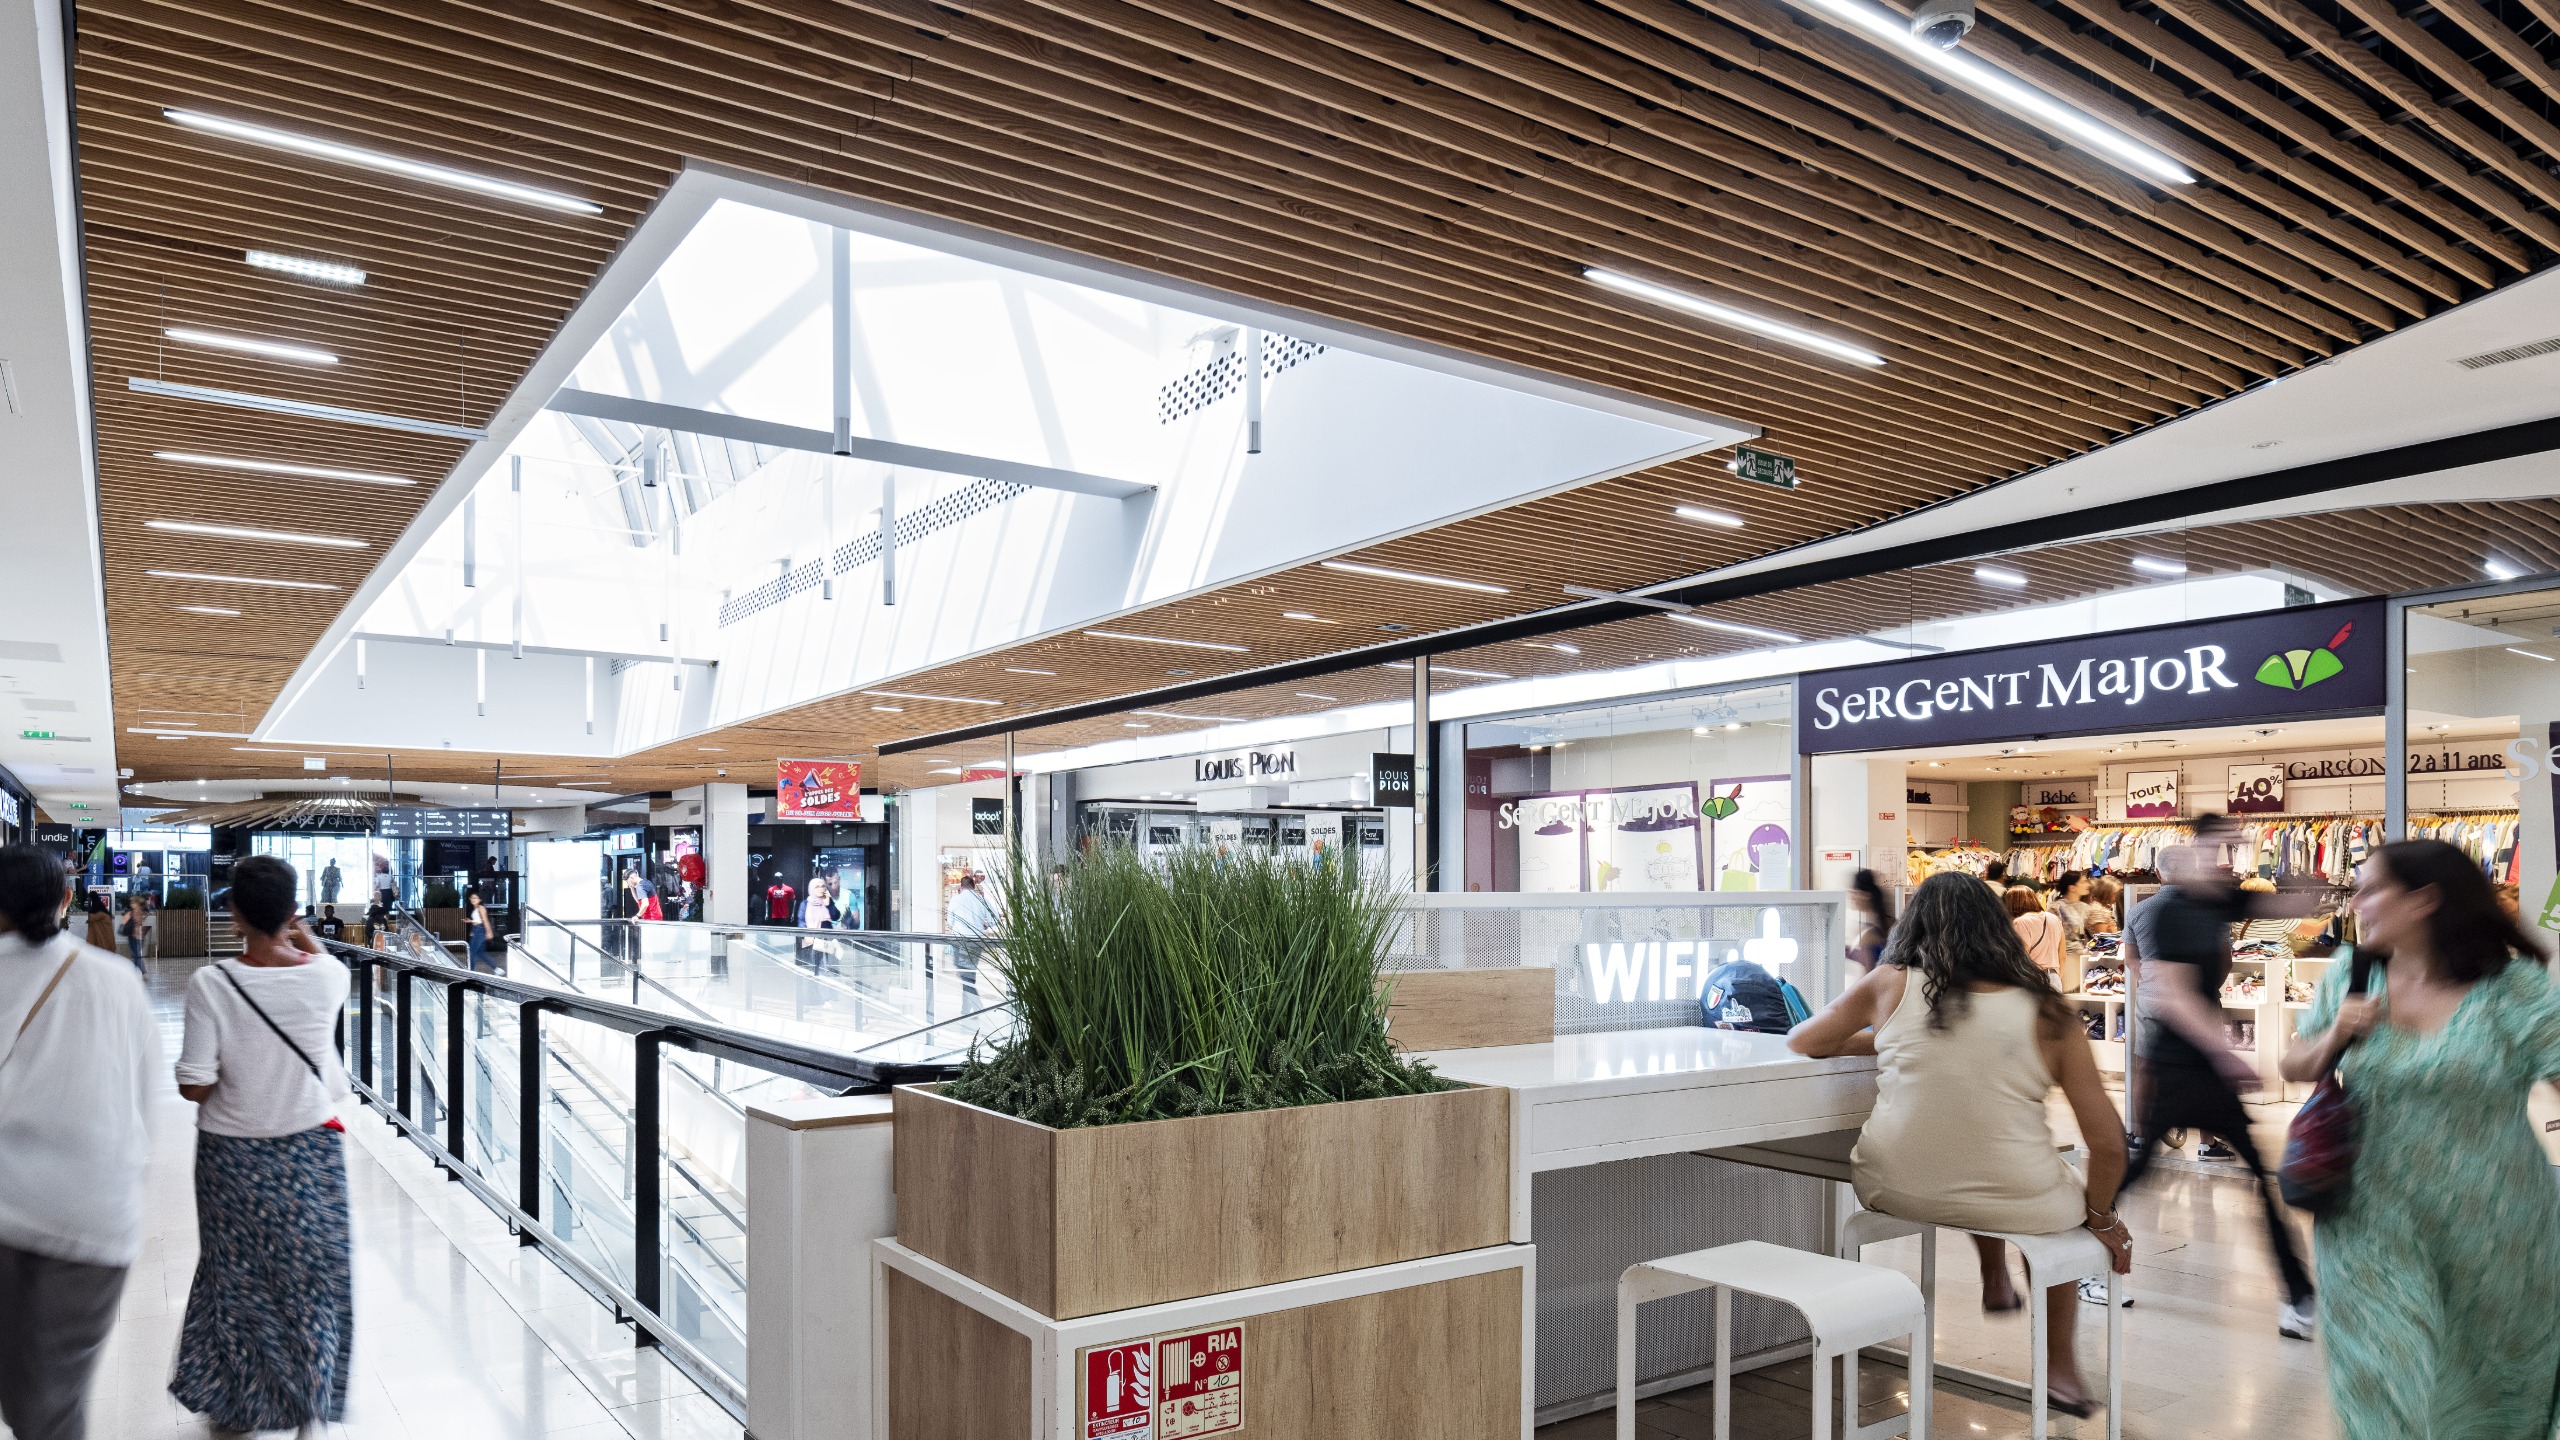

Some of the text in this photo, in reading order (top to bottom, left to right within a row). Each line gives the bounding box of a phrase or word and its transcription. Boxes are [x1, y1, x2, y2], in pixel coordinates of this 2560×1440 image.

[1195, 751, 1295, 782] LOUIS PION
[2410, 753, 2421, 773] 2
[2467, 752, 2503, 770] ans
[1379, 770, 1409, 780] LOUIS
[1379, 781, 1409, 791] PION
[2130, 780, 2176, 800] TOUT À
[800, 792, 840, 808] SOLDES
[2040, 790, 2077, 803] Bébé
[41, 833, 69, 842] undiz
[1216, 834, 1237, 842] SOLDES
[1311, 827, 1336, 835] SOLDES
[1207, 1332, 1238, 1353] RIA
[1194, 1374, 1230, 1391] N° 10
